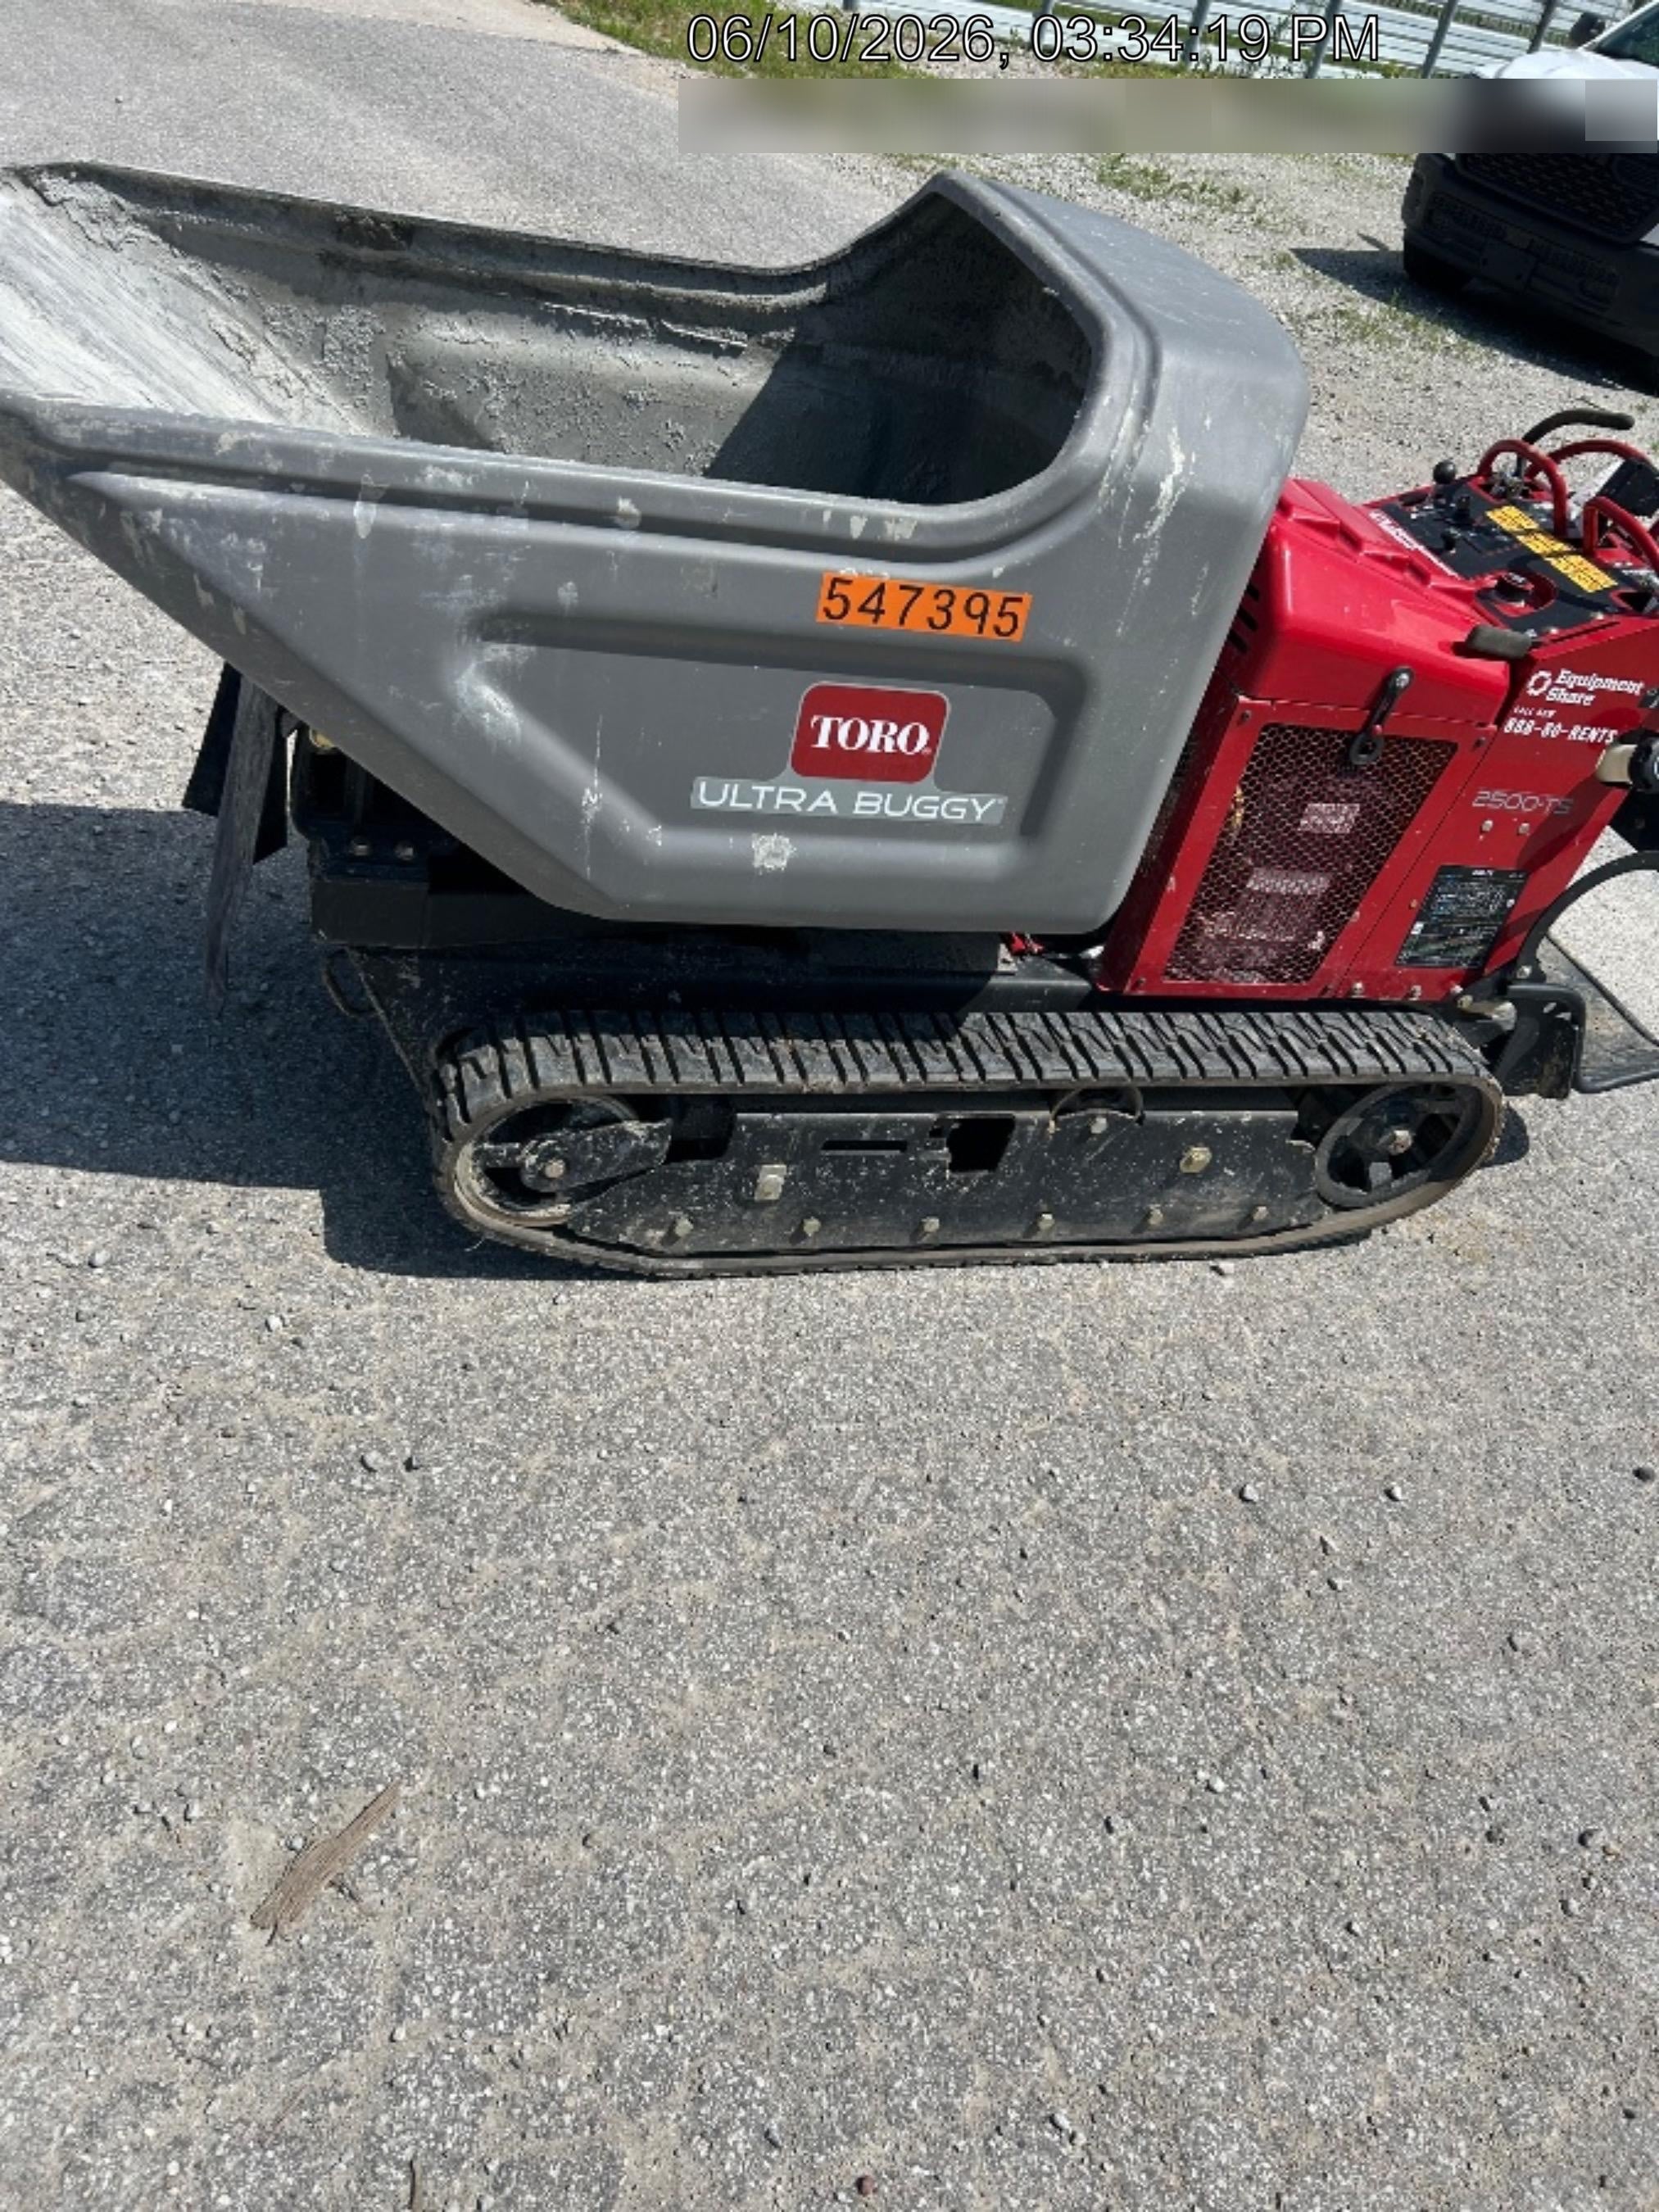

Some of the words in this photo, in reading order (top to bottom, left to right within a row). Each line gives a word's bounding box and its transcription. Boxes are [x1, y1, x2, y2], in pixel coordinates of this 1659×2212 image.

[823, 576, 1024, 637] 547395
[1545, 687, 1597, 705] Share
[1554, 668, 1645, 696] Equipment
[809, 714, 930, 756] TORO
[697, 780, 840, 814] ULTRA
[852, 791, 997, 822] BUGGY
[1471, 790, 1574, 816] 2500-TS
